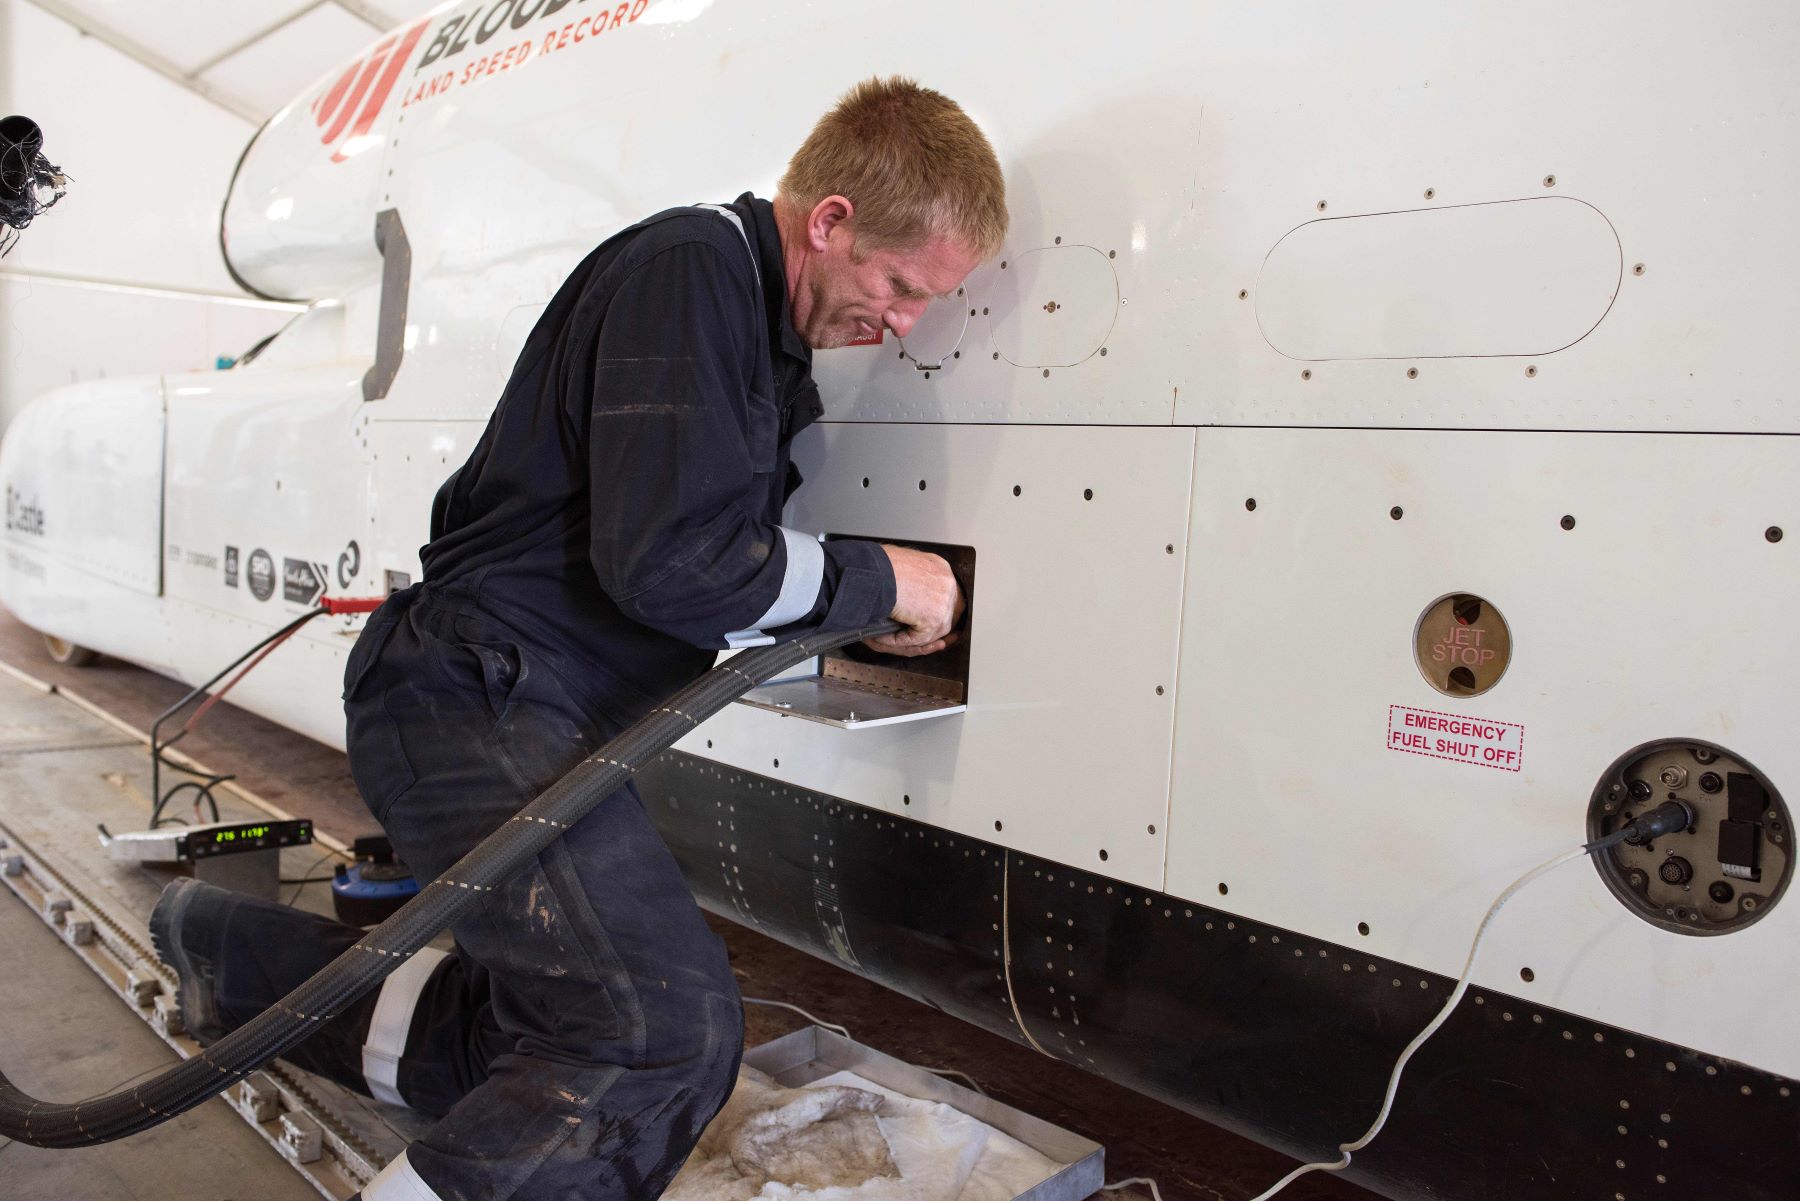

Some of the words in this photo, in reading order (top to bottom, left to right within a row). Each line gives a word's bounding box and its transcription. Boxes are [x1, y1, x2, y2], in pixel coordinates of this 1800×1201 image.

[402, 70, 455, 108] LAND
[460, 40, 532, 86] SPEED
[539, 0, 649, 57] RECORD
[1442, 627, 1486, 646] JET
[1432, 645, 1496, 666] STOP
[1404, 713, 1506, 741] EMERGENCY
[1392, 731, 1431, 750] FUEL
[1436, 739, 1479, 758] SHUT
[1483, 747, 1516, 764] OFF
